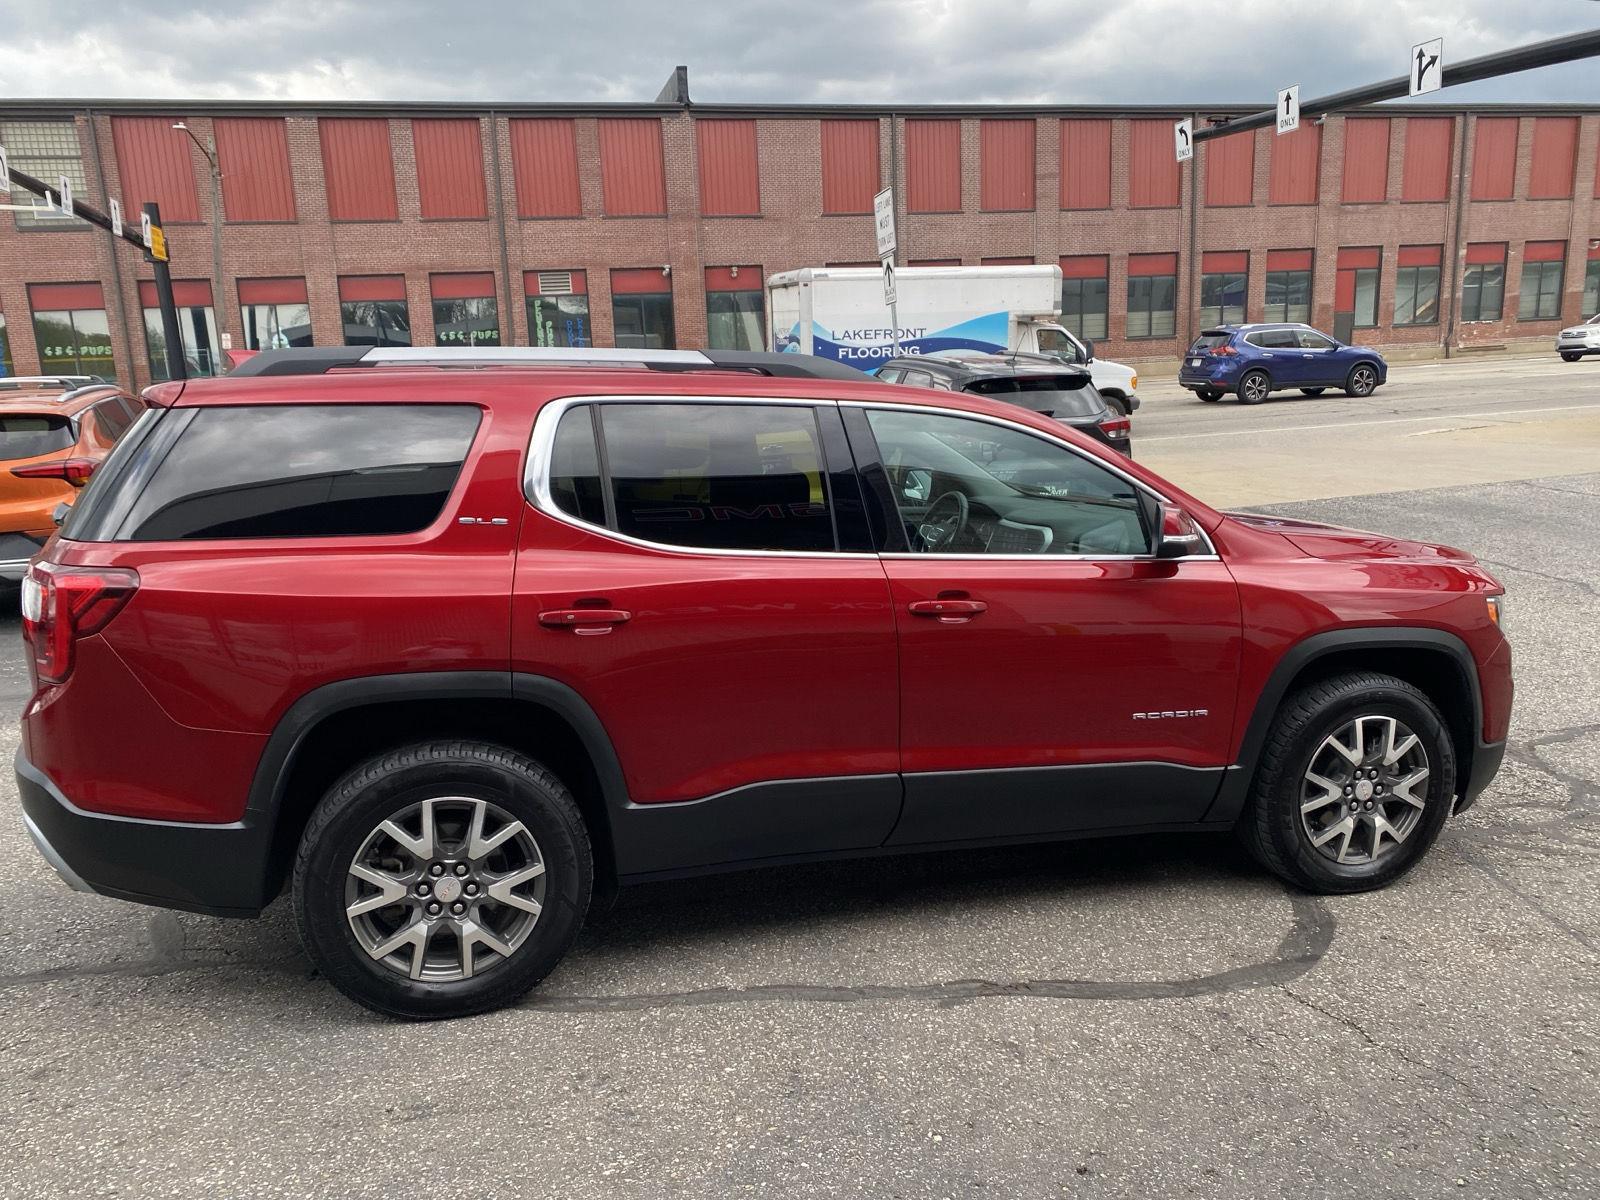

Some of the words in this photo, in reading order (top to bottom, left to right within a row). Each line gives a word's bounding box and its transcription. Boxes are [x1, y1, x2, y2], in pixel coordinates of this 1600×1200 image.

[1280, 118, 1295, 128] ONLY
[1178, 148, 1190, 158] ONLY
[832, 328, 927, 340] LAKEFRONT
[838, 346, 920, 359] FLOORING
[1132, 709, 1209, 720] ACADIA
